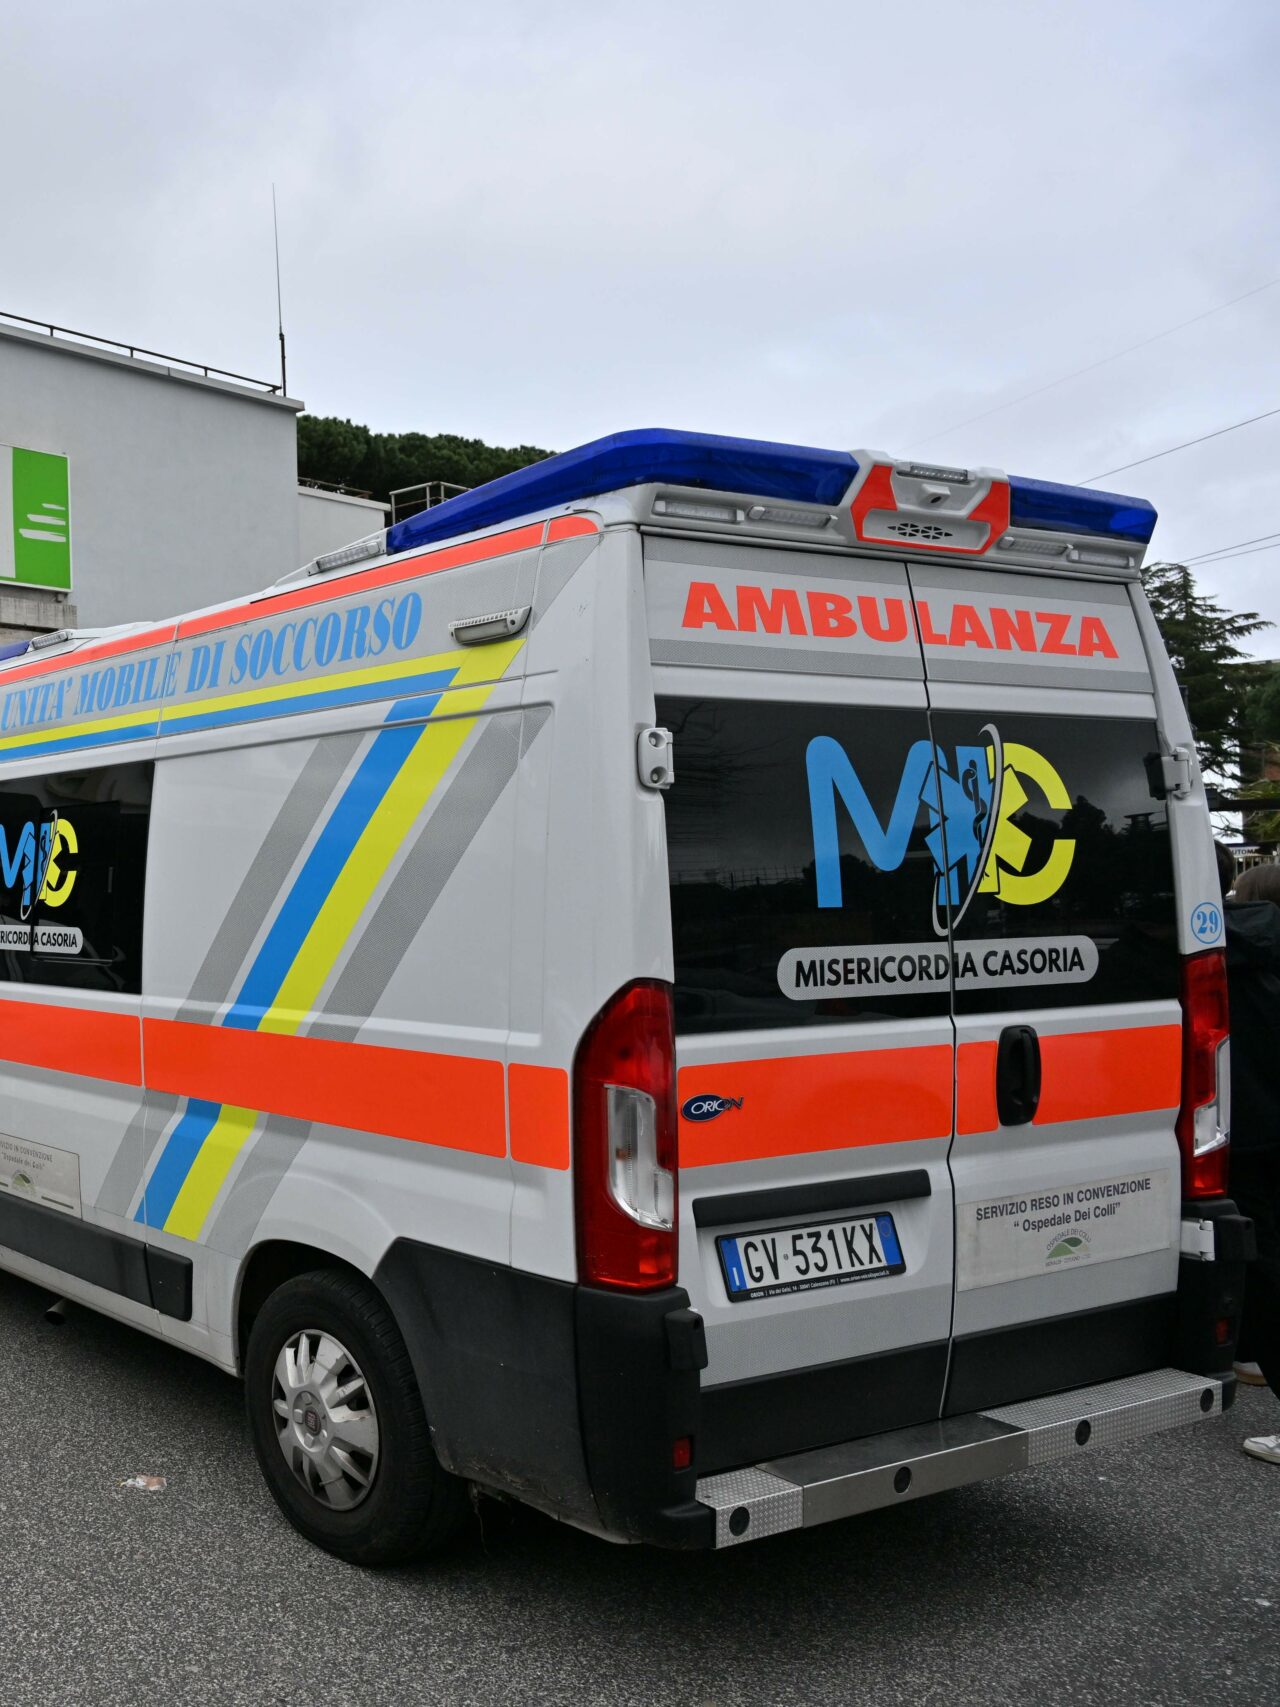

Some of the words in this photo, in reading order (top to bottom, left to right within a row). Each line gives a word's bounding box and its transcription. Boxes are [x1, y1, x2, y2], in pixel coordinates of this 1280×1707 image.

[681, 581, 1120, 659] AMBULANZA
[73, 651, 182, 716] MOBILE
[187, 640, 228, 694] DI
[228, 591, 422, 686] SOCCORSO
[41, 932, 77, 948] CASORIA
[1197, 910, 1219, 934] 29
[795, 952, 978, 988] MISERICORDIA
[983, 947, 1085, 977] CASORIA
[691, 1096, 744, 1115] ORION
[976, 1200, 1027, 1221] SERVIZIO
[1030, 1195, 1060, 1211] RESO
[1063, 1193, 1074, 1205] IN
[1077, 1178, 1151, 1203] CONVENZIONE
[1023, 1212, 1071, 1232] Ospedale
[1075, 1207, 1090, 1222] Dei
[743, 1237, 780, 1283] GV
[792, 1223, 882, 1275] 531KX
